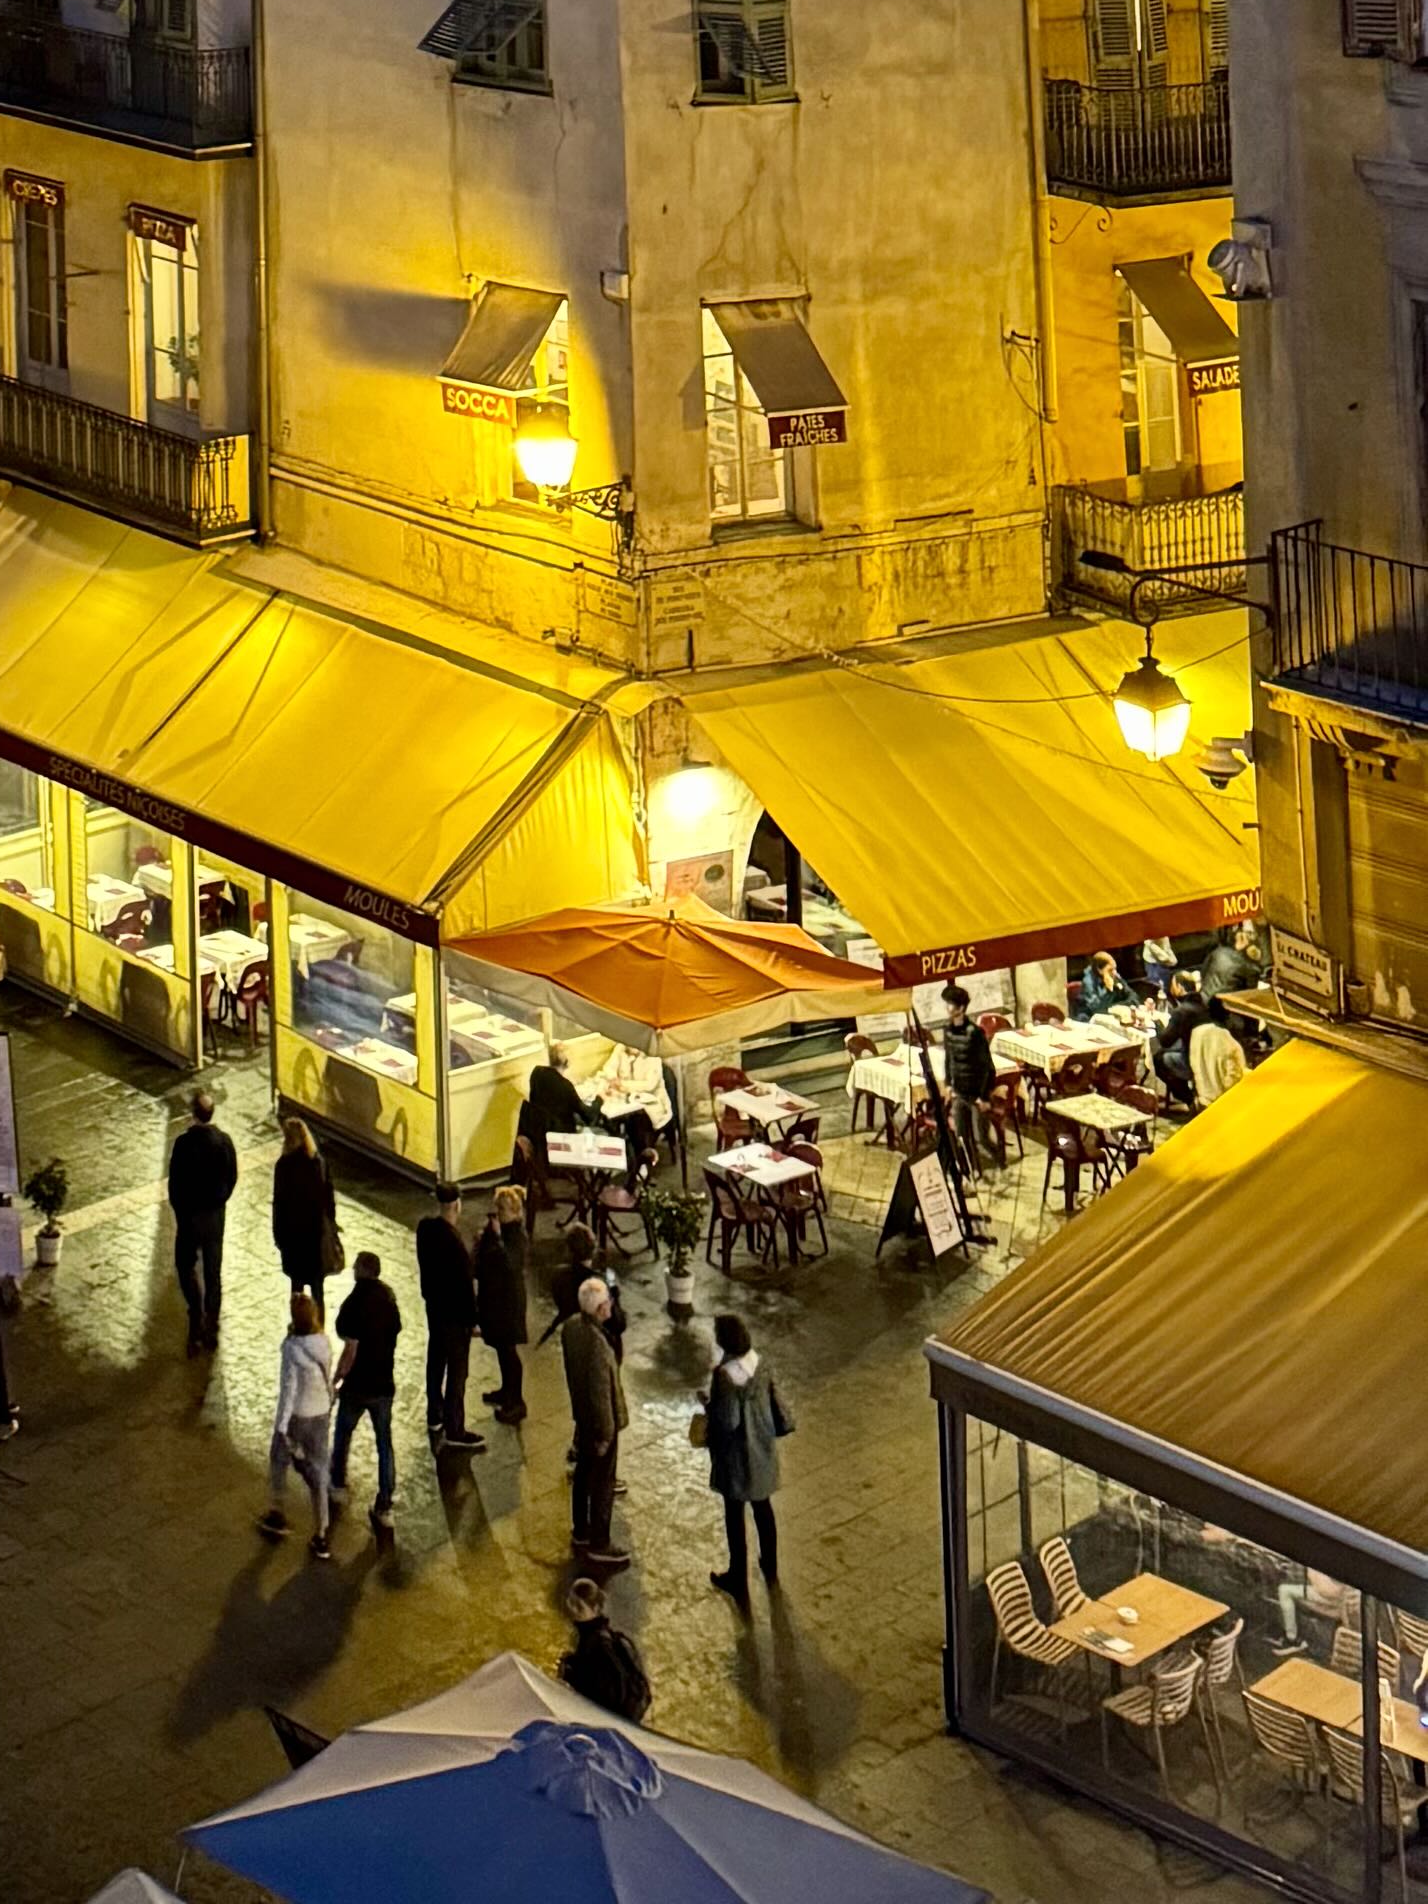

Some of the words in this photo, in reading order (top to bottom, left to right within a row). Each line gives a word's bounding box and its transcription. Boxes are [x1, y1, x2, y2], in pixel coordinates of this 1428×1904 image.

[446, 387, 511, 420] SOCCA
[344, 885, 410, 930] MOULES
[922, 946, 977, 976] PIZZAS
